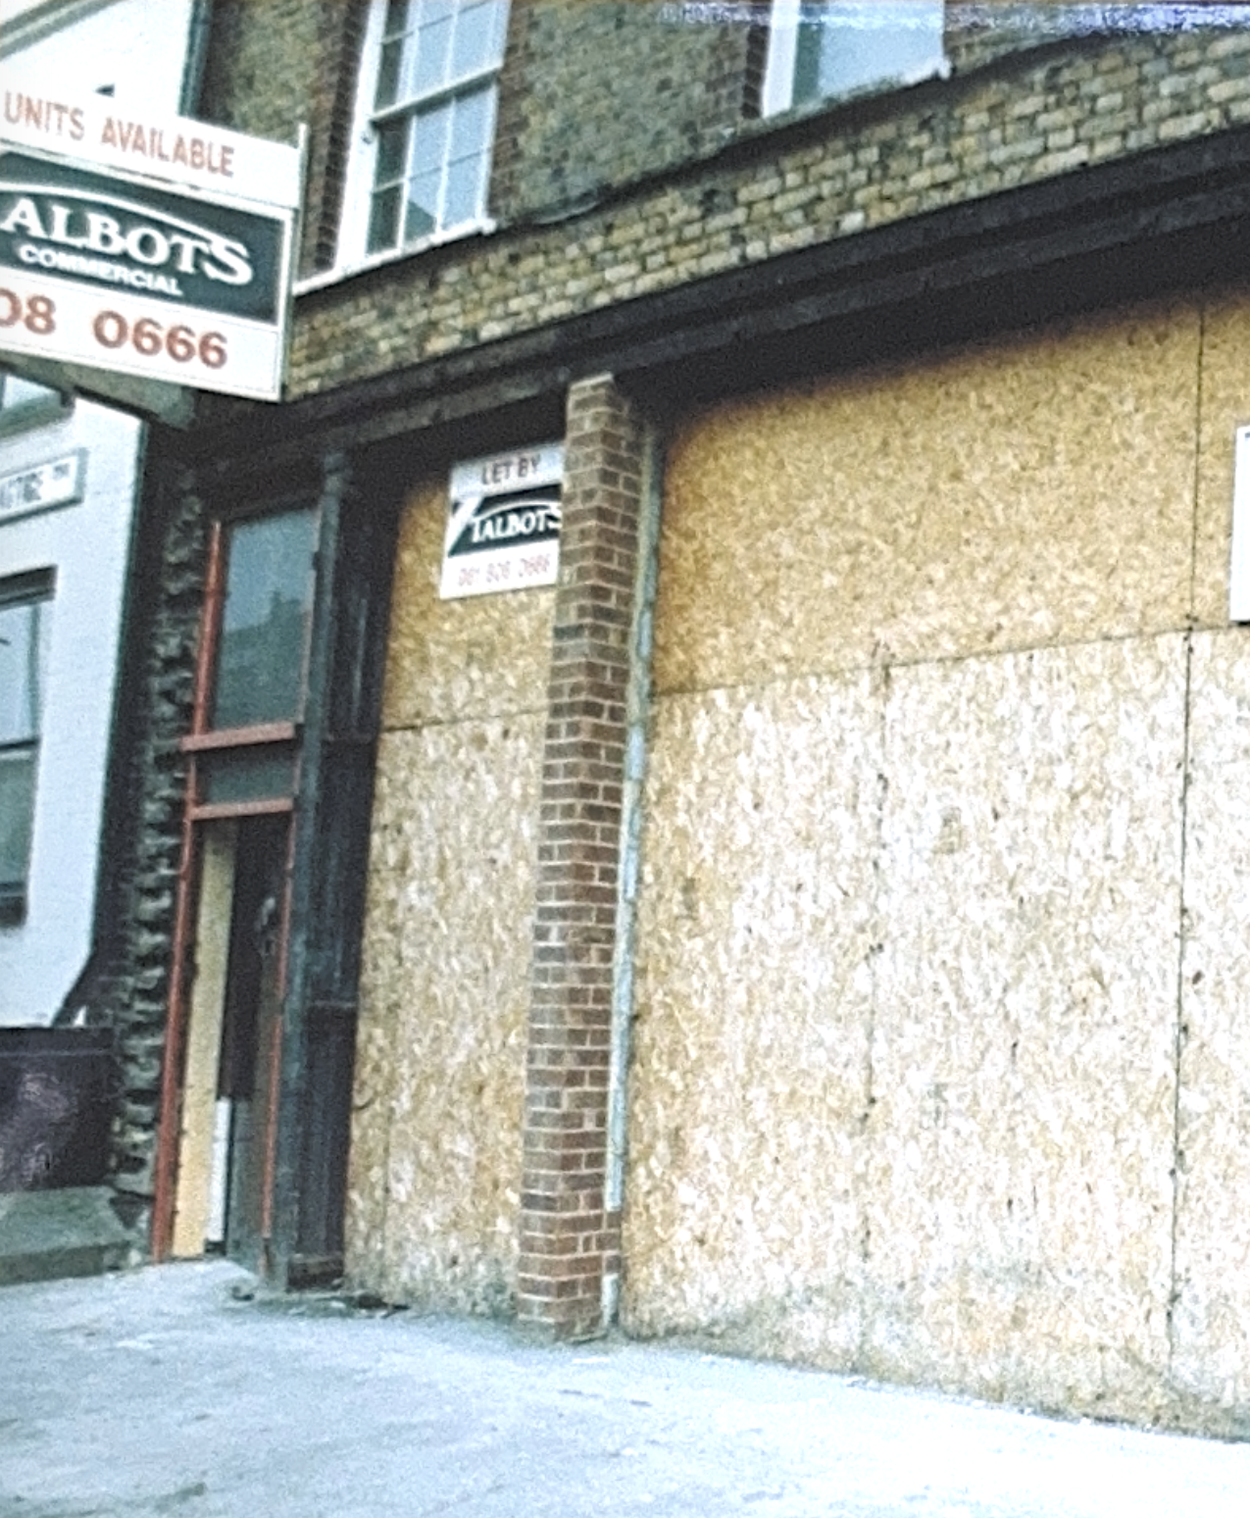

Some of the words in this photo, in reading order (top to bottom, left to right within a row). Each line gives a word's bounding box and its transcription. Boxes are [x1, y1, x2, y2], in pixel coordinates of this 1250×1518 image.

[4, 90, 85, 141] UNITS
[101, 115, 235, 178] AVAILABLE
[18, 243, 183, 296] COMMERCIAL
[92, 309, 228, 369] 0666
[481, 460, 514, 485] LET
[517, 453, 542, 478] BY
